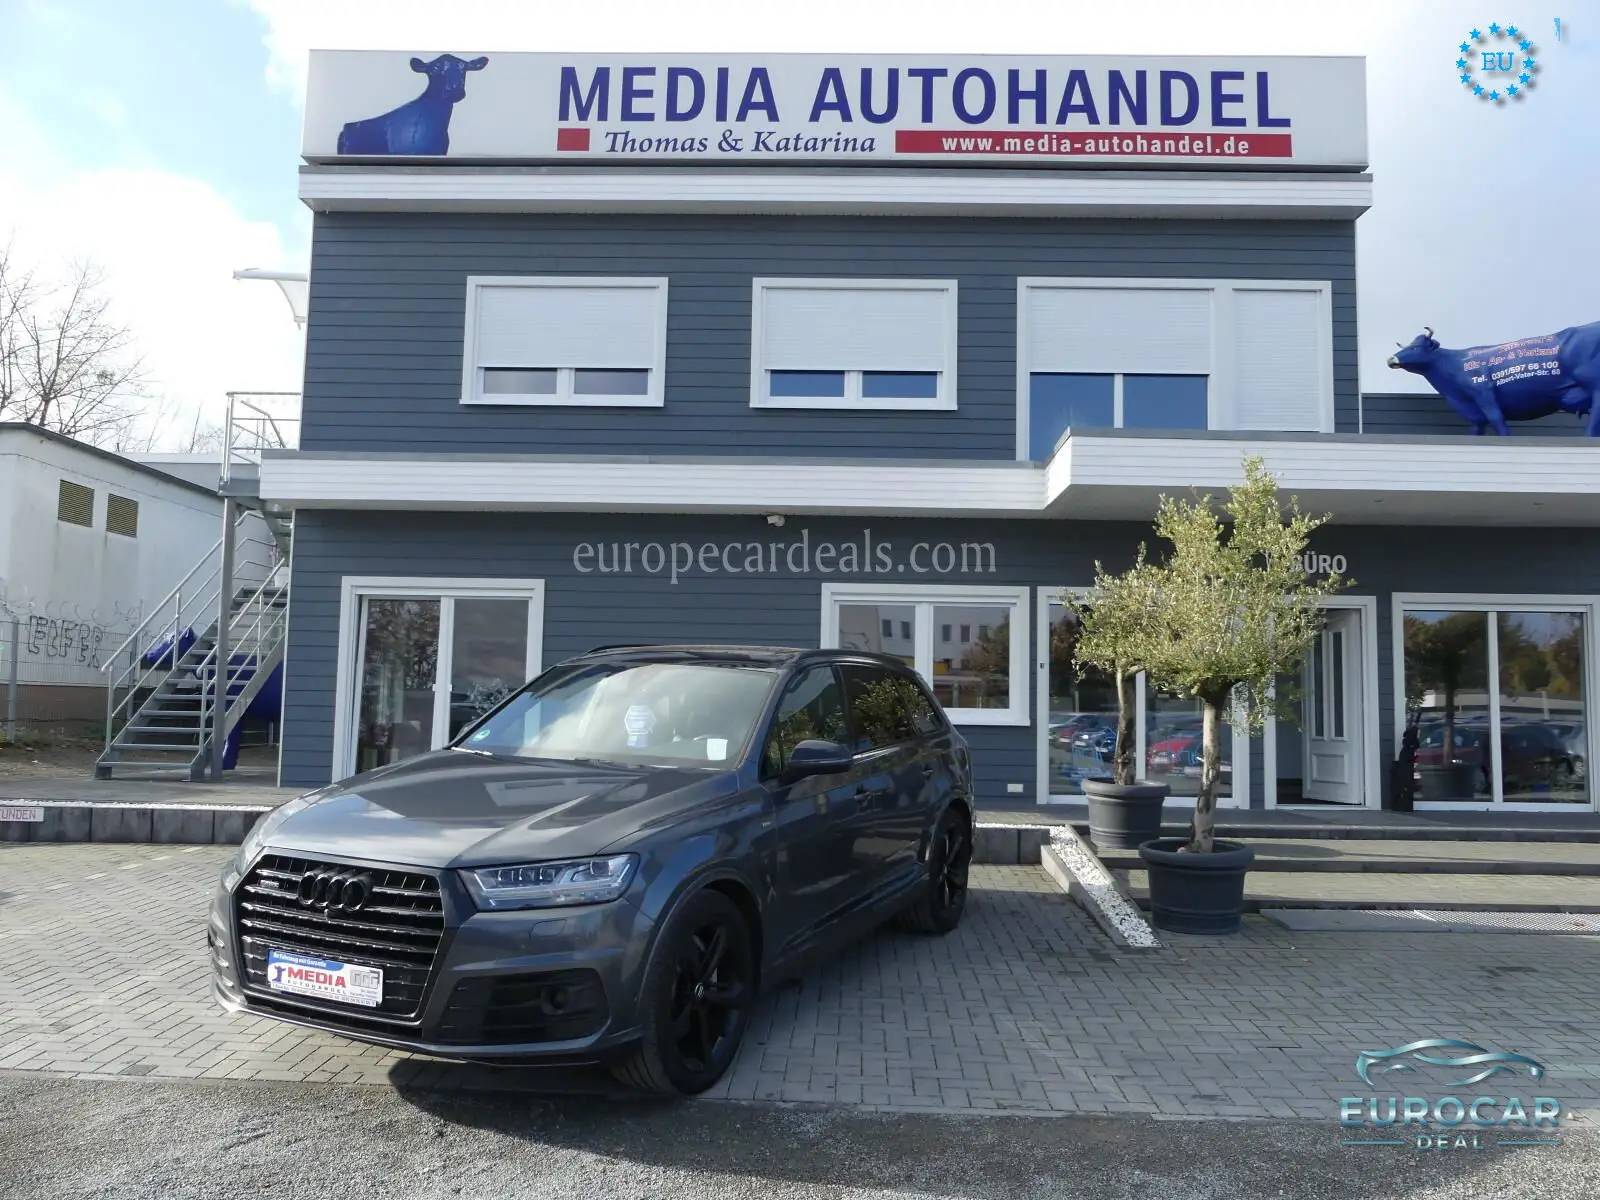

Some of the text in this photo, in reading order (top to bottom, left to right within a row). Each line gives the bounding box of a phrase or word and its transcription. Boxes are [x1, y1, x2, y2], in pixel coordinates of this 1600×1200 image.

[558, 66, 1291, 128] MEDIA AUTOHANDEL
[604, 128, 876, 153] Thomas & Katarina
[942, 134, 1249, 155] www.media-autohandel.de
[1472, 375, 1488, 383] Tel.
[1541, 361, 1559, 369] 100
[0, 807, 37, 820] UNDEN
[287, 967, 346, 988] MEDIA
[288, 980, 347, 995] AUTOHANDEL
